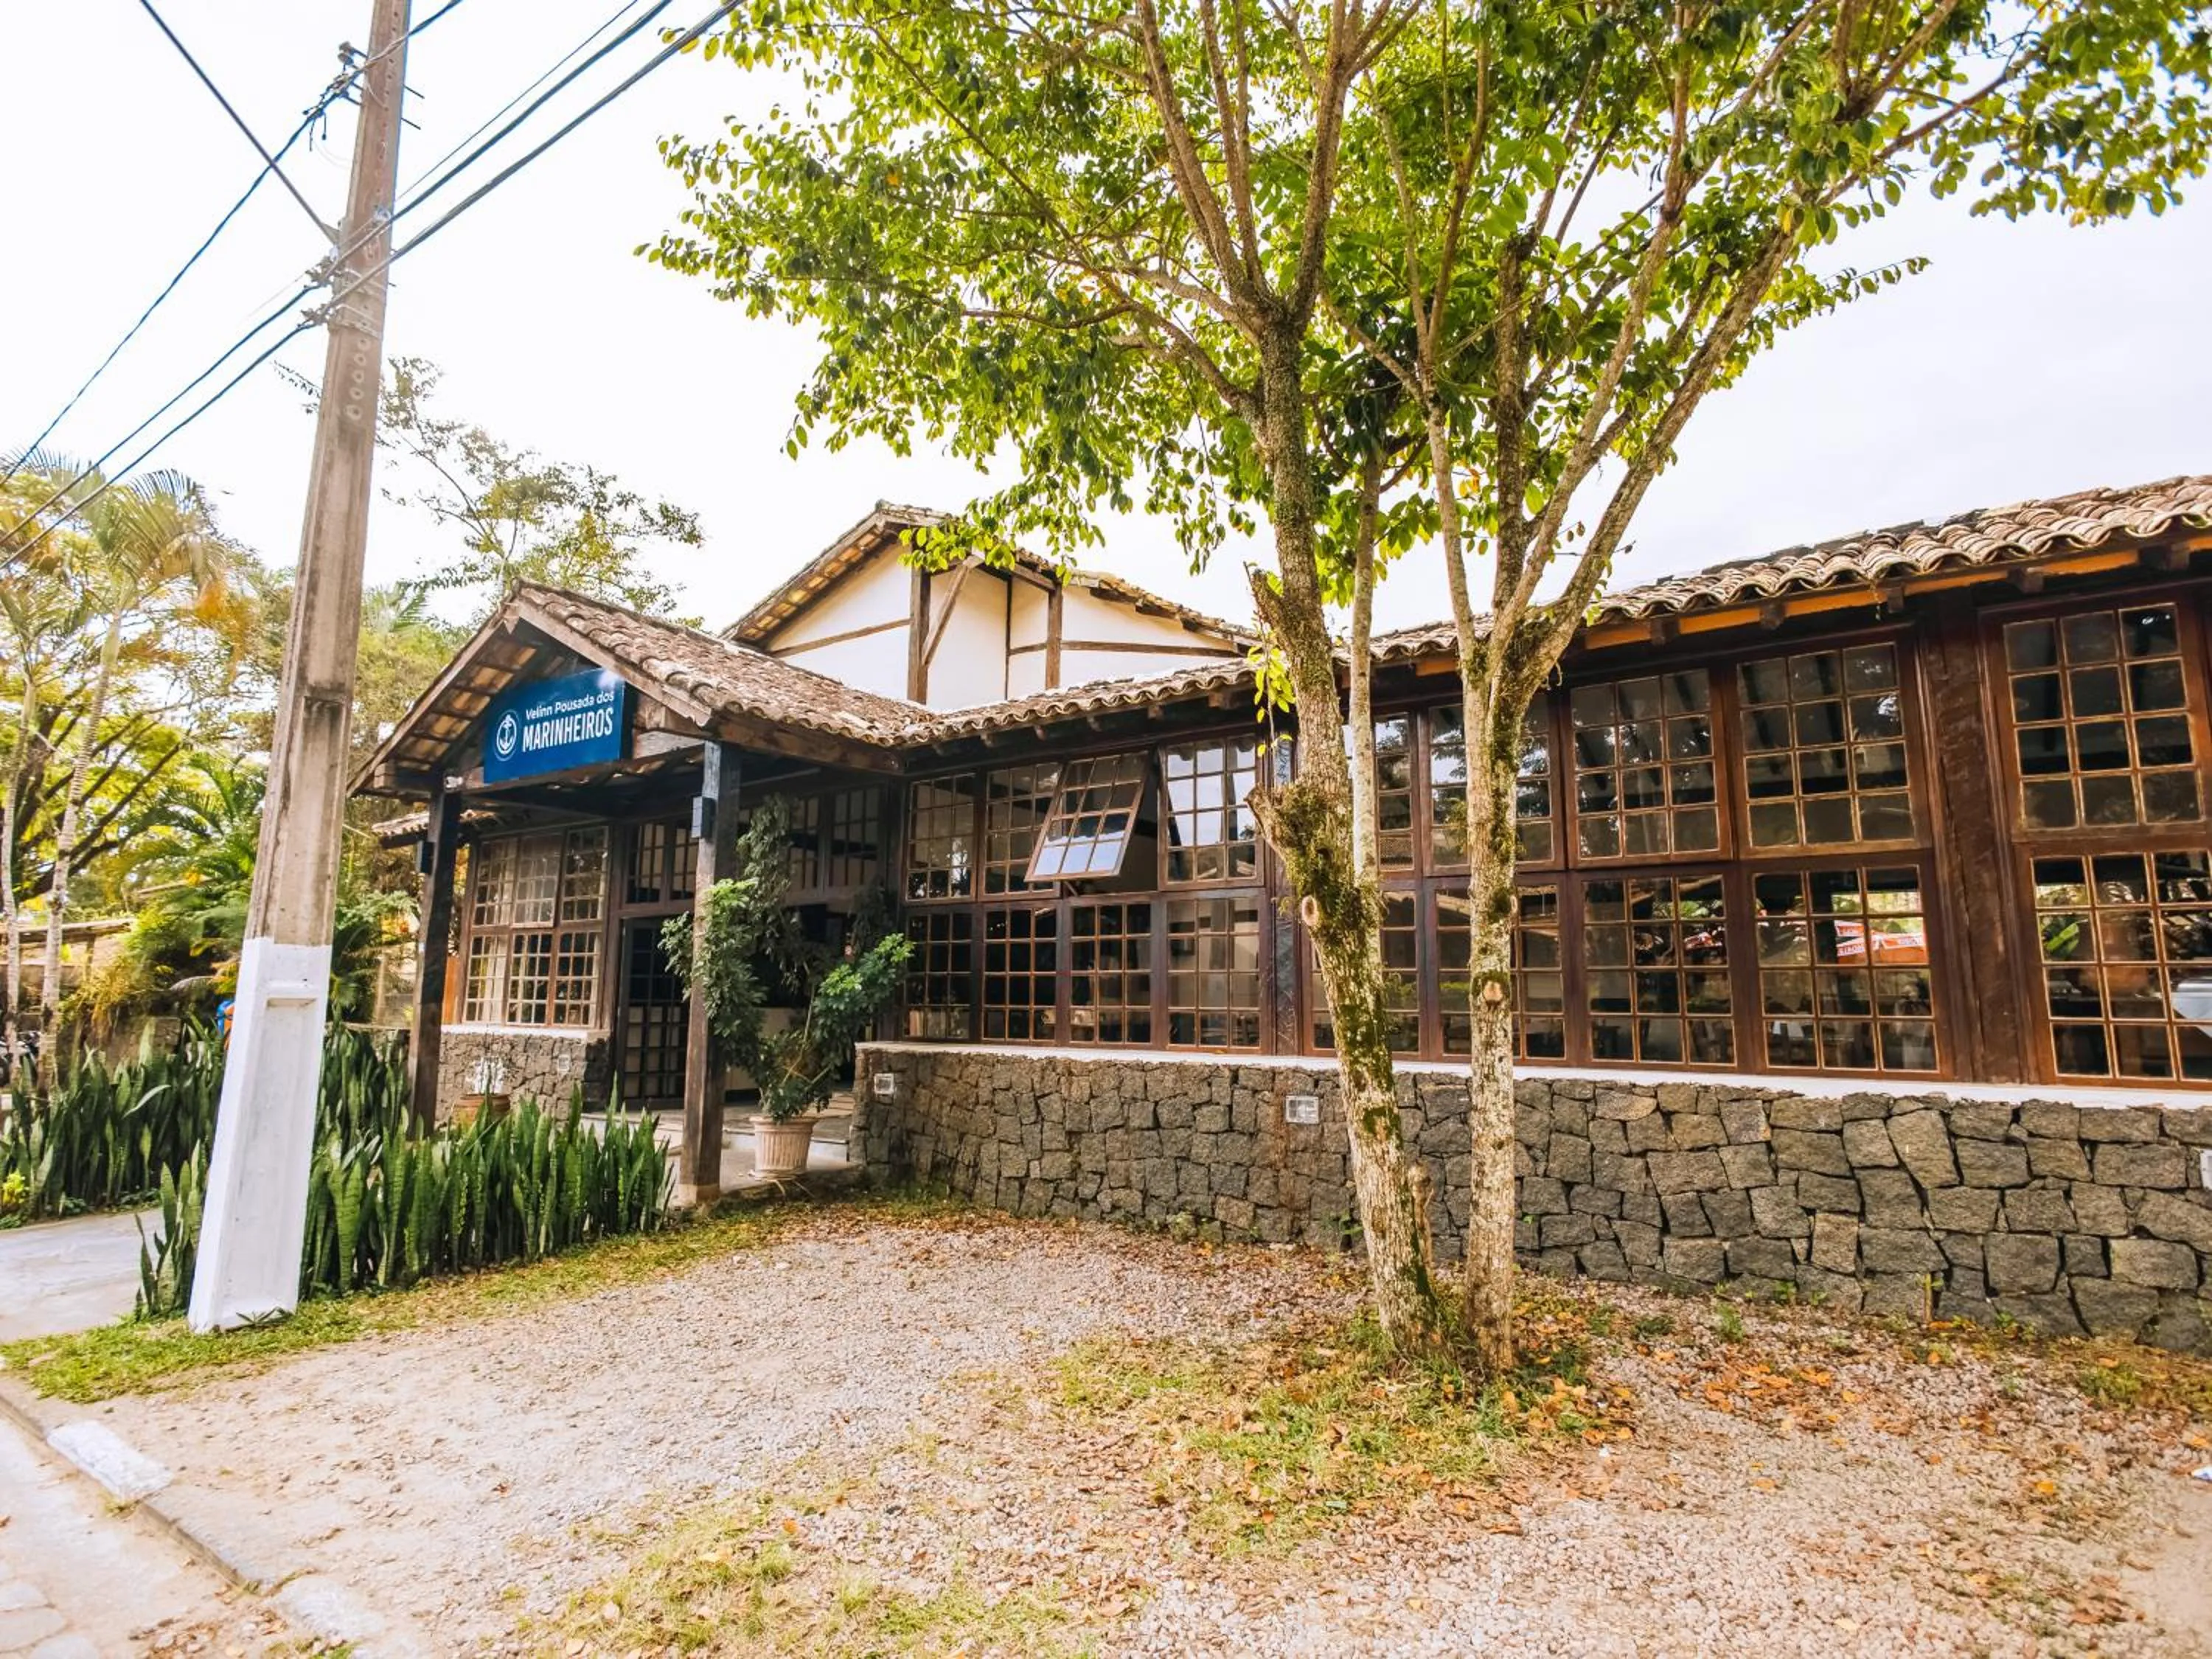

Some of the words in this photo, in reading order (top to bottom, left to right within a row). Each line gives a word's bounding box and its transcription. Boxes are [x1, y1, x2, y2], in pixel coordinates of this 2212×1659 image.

[526, 705, 552, 720] Velinn
[554, 694, 594, 714] Pousada
[597, 690, 614, 704] dos
[522, 706, 614, 753] MARINHEIROS
